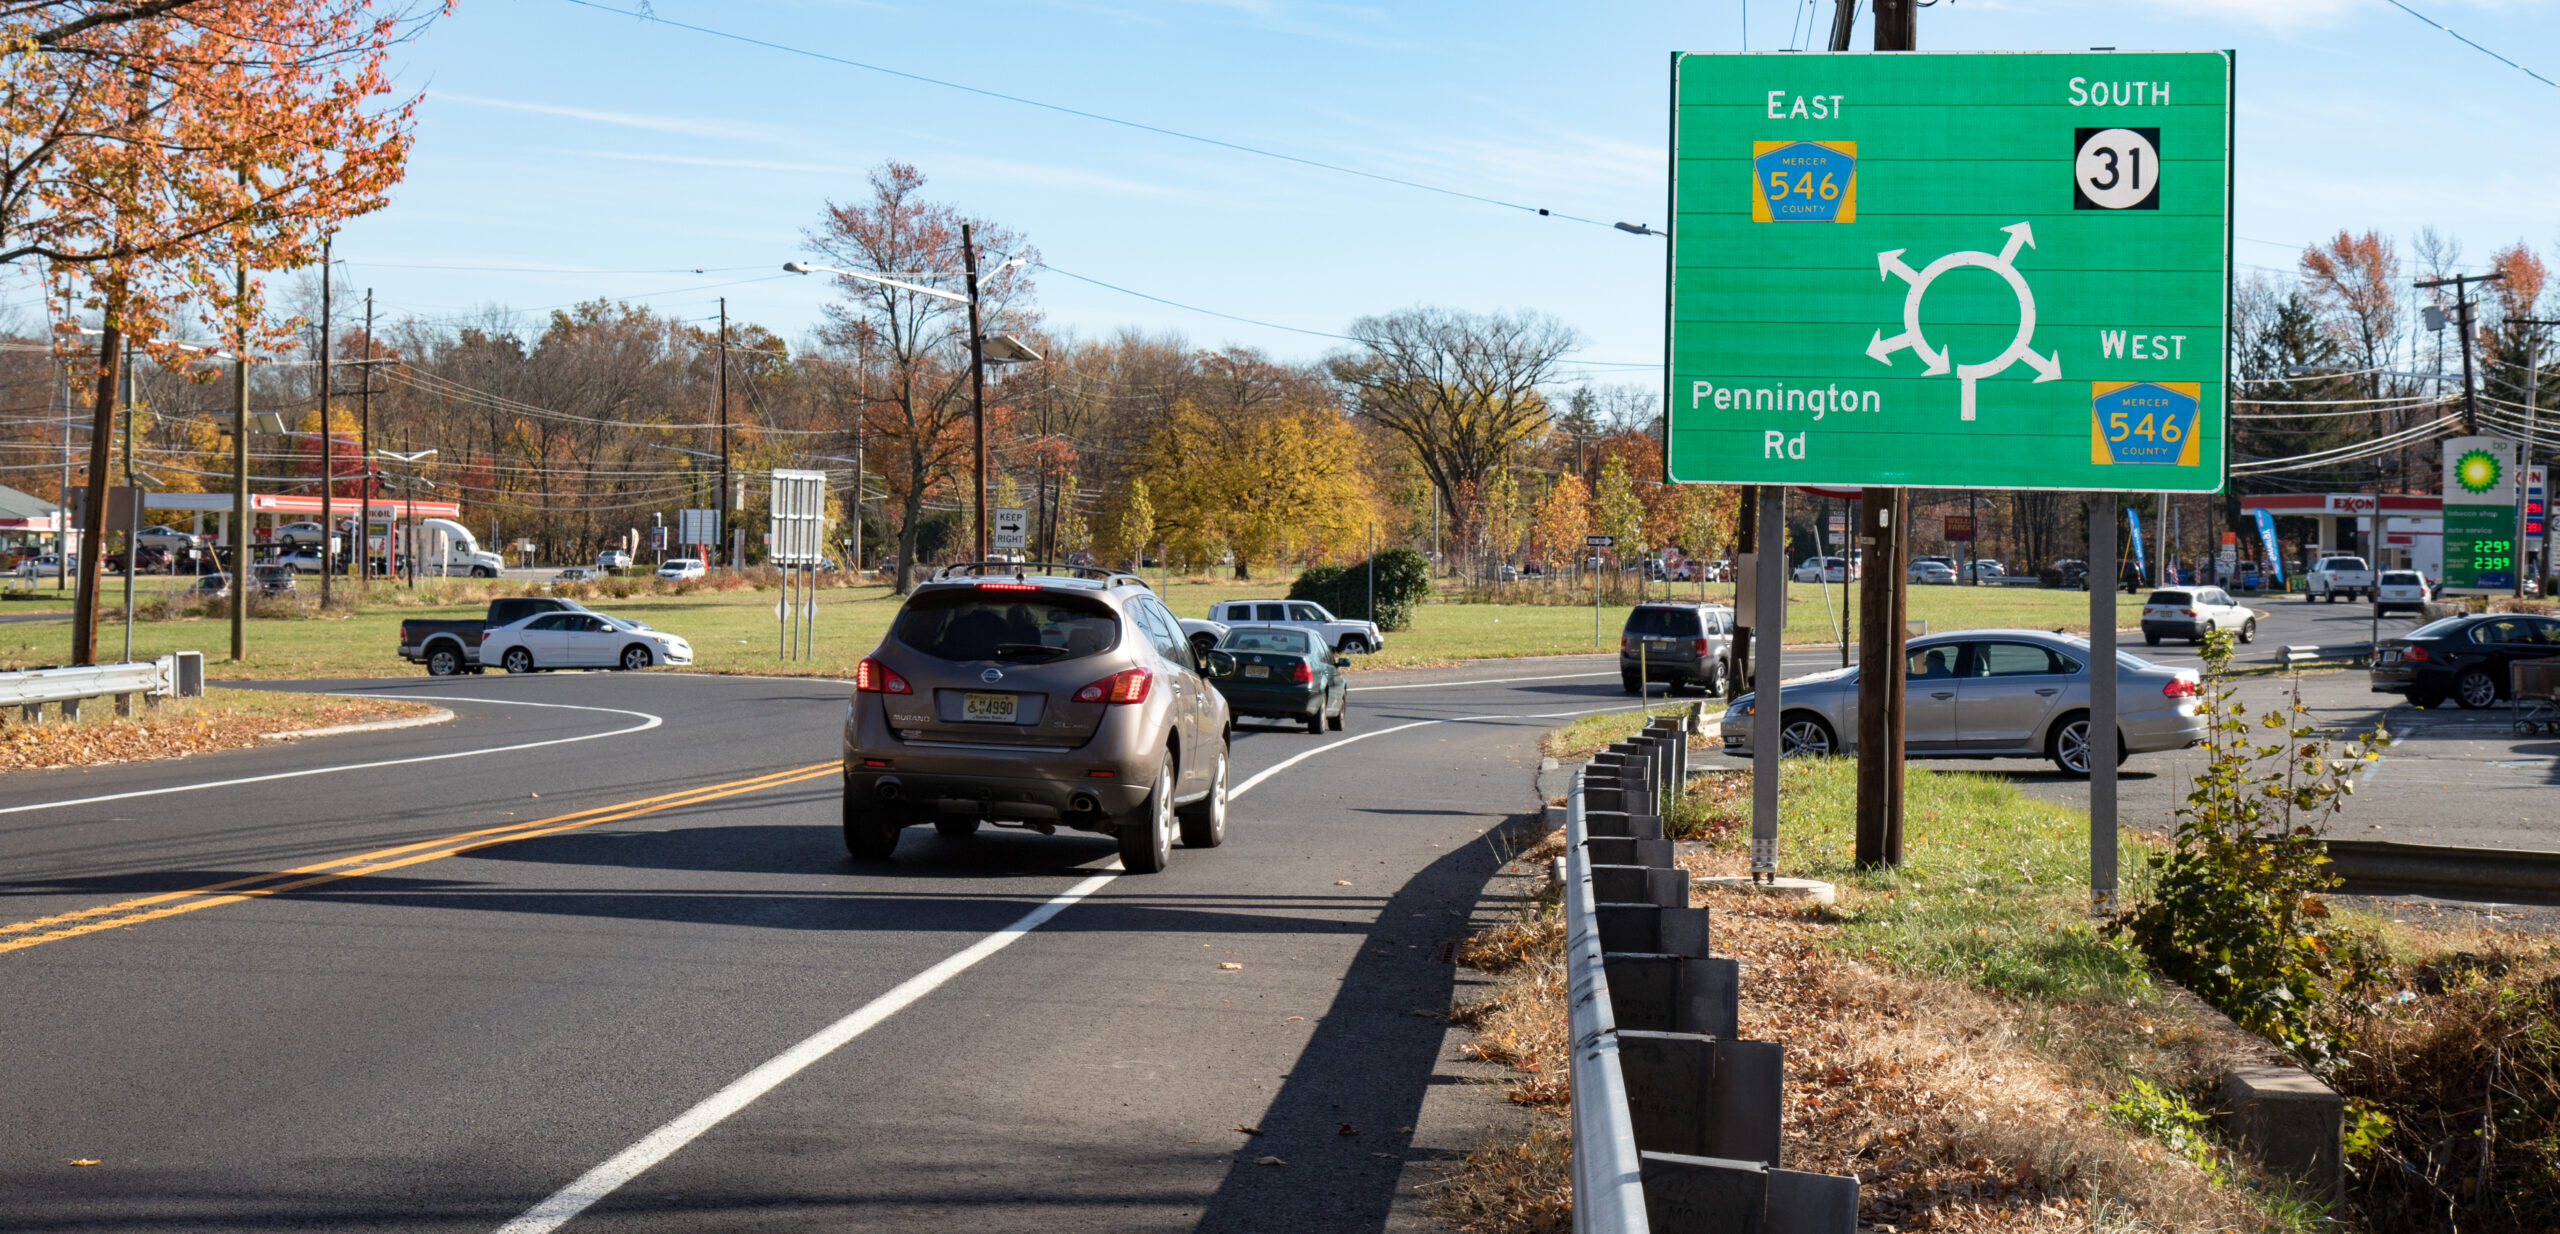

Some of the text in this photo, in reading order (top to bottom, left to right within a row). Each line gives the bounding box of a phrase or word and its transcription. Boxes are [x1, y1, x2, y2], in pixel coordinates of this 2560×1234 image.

[2068, 77, 2170, 106] SOUTH
[1768, 91, 1844, 119] EAST
[1782, 158, 1827, 166] MERCER
[2090, 147, 2140, 190] 31
[1769, 171, 1839, 200] 546
[1781, 205, 1826, 213] COUNTY
[2100, 331, 2187, 359] WEST
[1692, 381, 1880, 420] Pennington
[2122, 399, 2169, 407] MERCER
[2109, 412, 2182, 442] 546
[1764, 431, 1806, 460] Rd
[2121, 447, 2168, 456] COUNTY
[2492, 440, 2508, 452] bp
[2334, 496, 2375, 513] EXXON
[1000, 513, 1023, 521] KEEP
[997, 534, 1023, 543] RIGHT
[893, 713, 931, 723] MURANO
